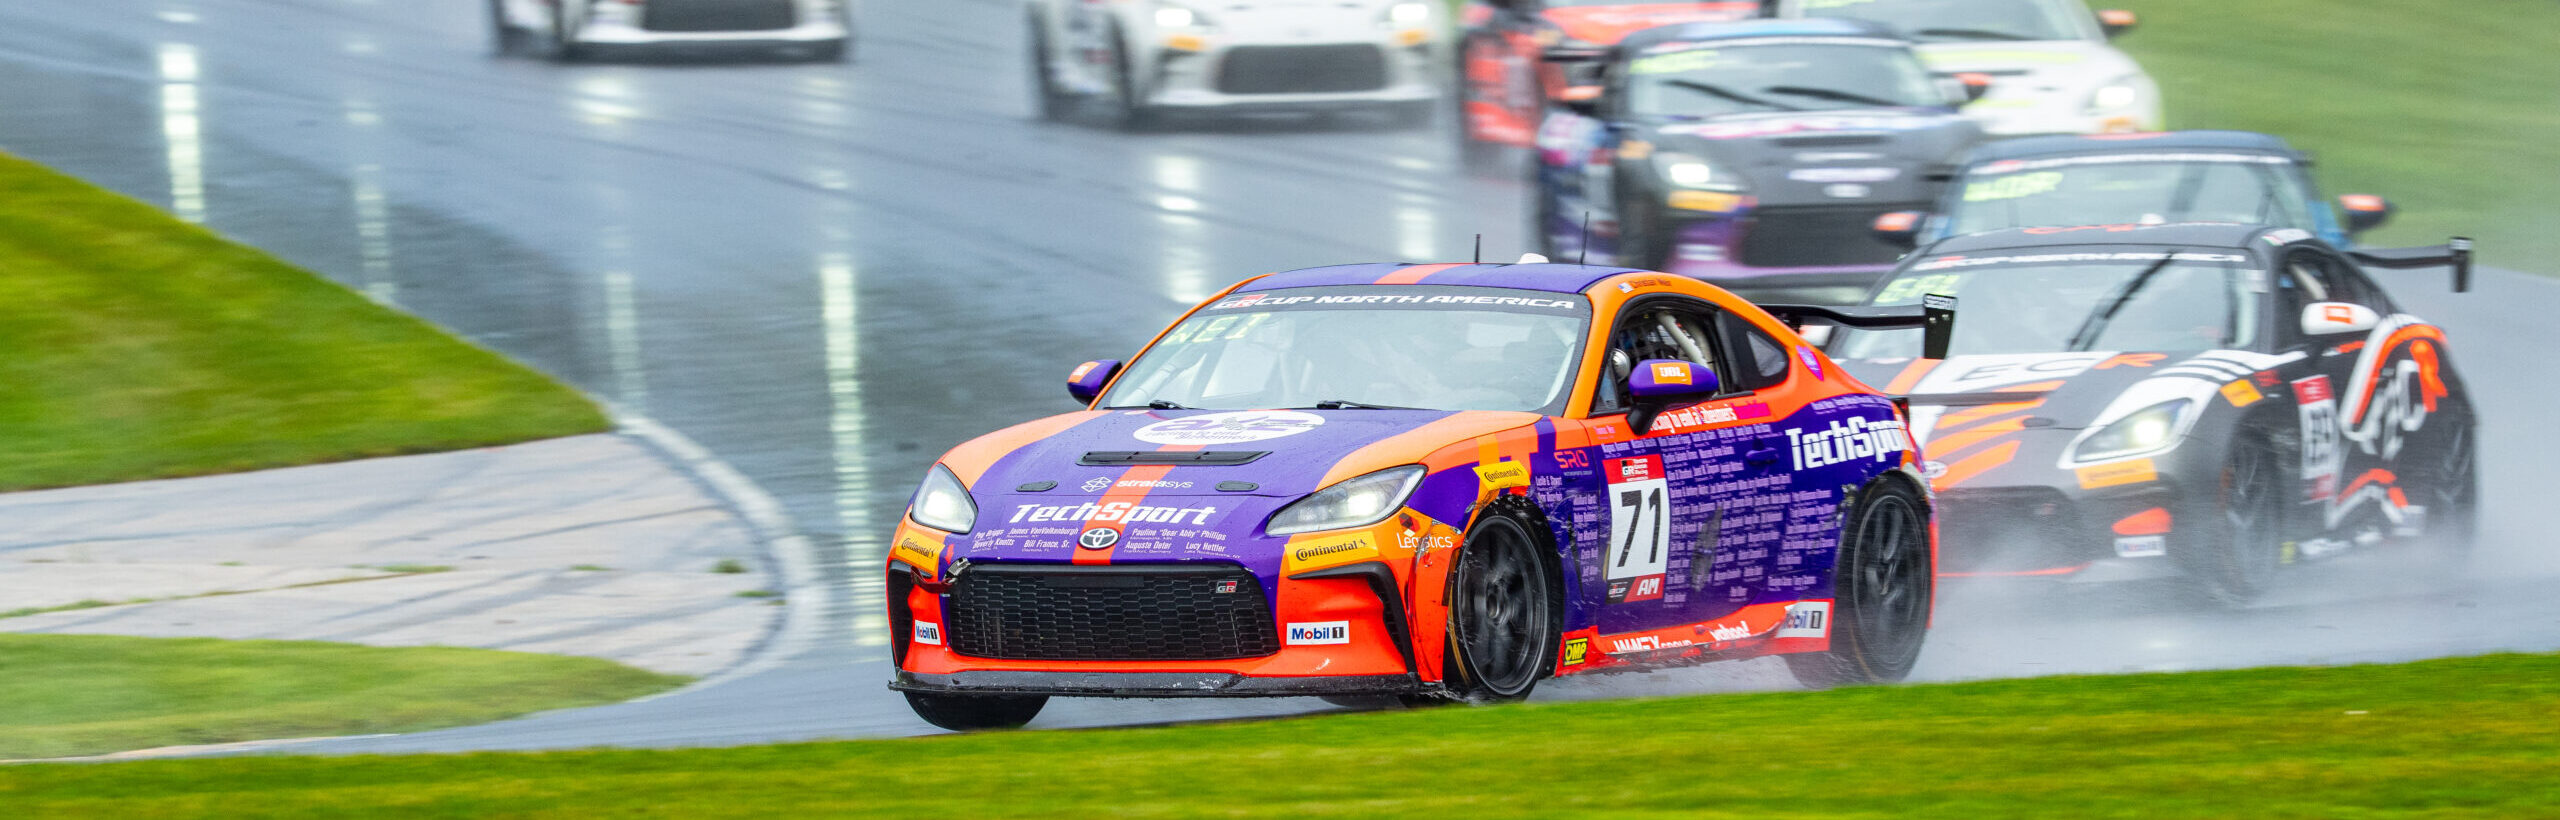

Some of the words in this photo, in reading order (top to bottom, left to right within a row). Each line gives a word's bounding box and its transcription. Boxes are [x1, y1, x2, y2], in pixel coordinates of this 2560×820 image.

[1256, 296, 1315, 306] CUP
[1316, 295, 1424, 305] NORTH
[1426, 295, 1575, 310] AMERICA
[1659, 366, 1686, 378] JBL
[1554, 450, 1589, 468] SRO
[1116, 479, 1194, 489] stratasys
[1008, 501, 1217, 526] TechSport
[1007, 527, 1029, 535] James
[1617, 487, 1661, 568] 71
[1023, 539, 1037, 549] Bill
[1295, 540, 1359, 562] Continental
[1636, 577, 1661, 596] AM
[916, 625, 931, 639] Mobil
[930, 627, 938, 640] 1
[1291, 627, 1330, 640] Mobil
[1332, 626, 1345, 639] 1
[1565, 643, 1587, 661] OMP
